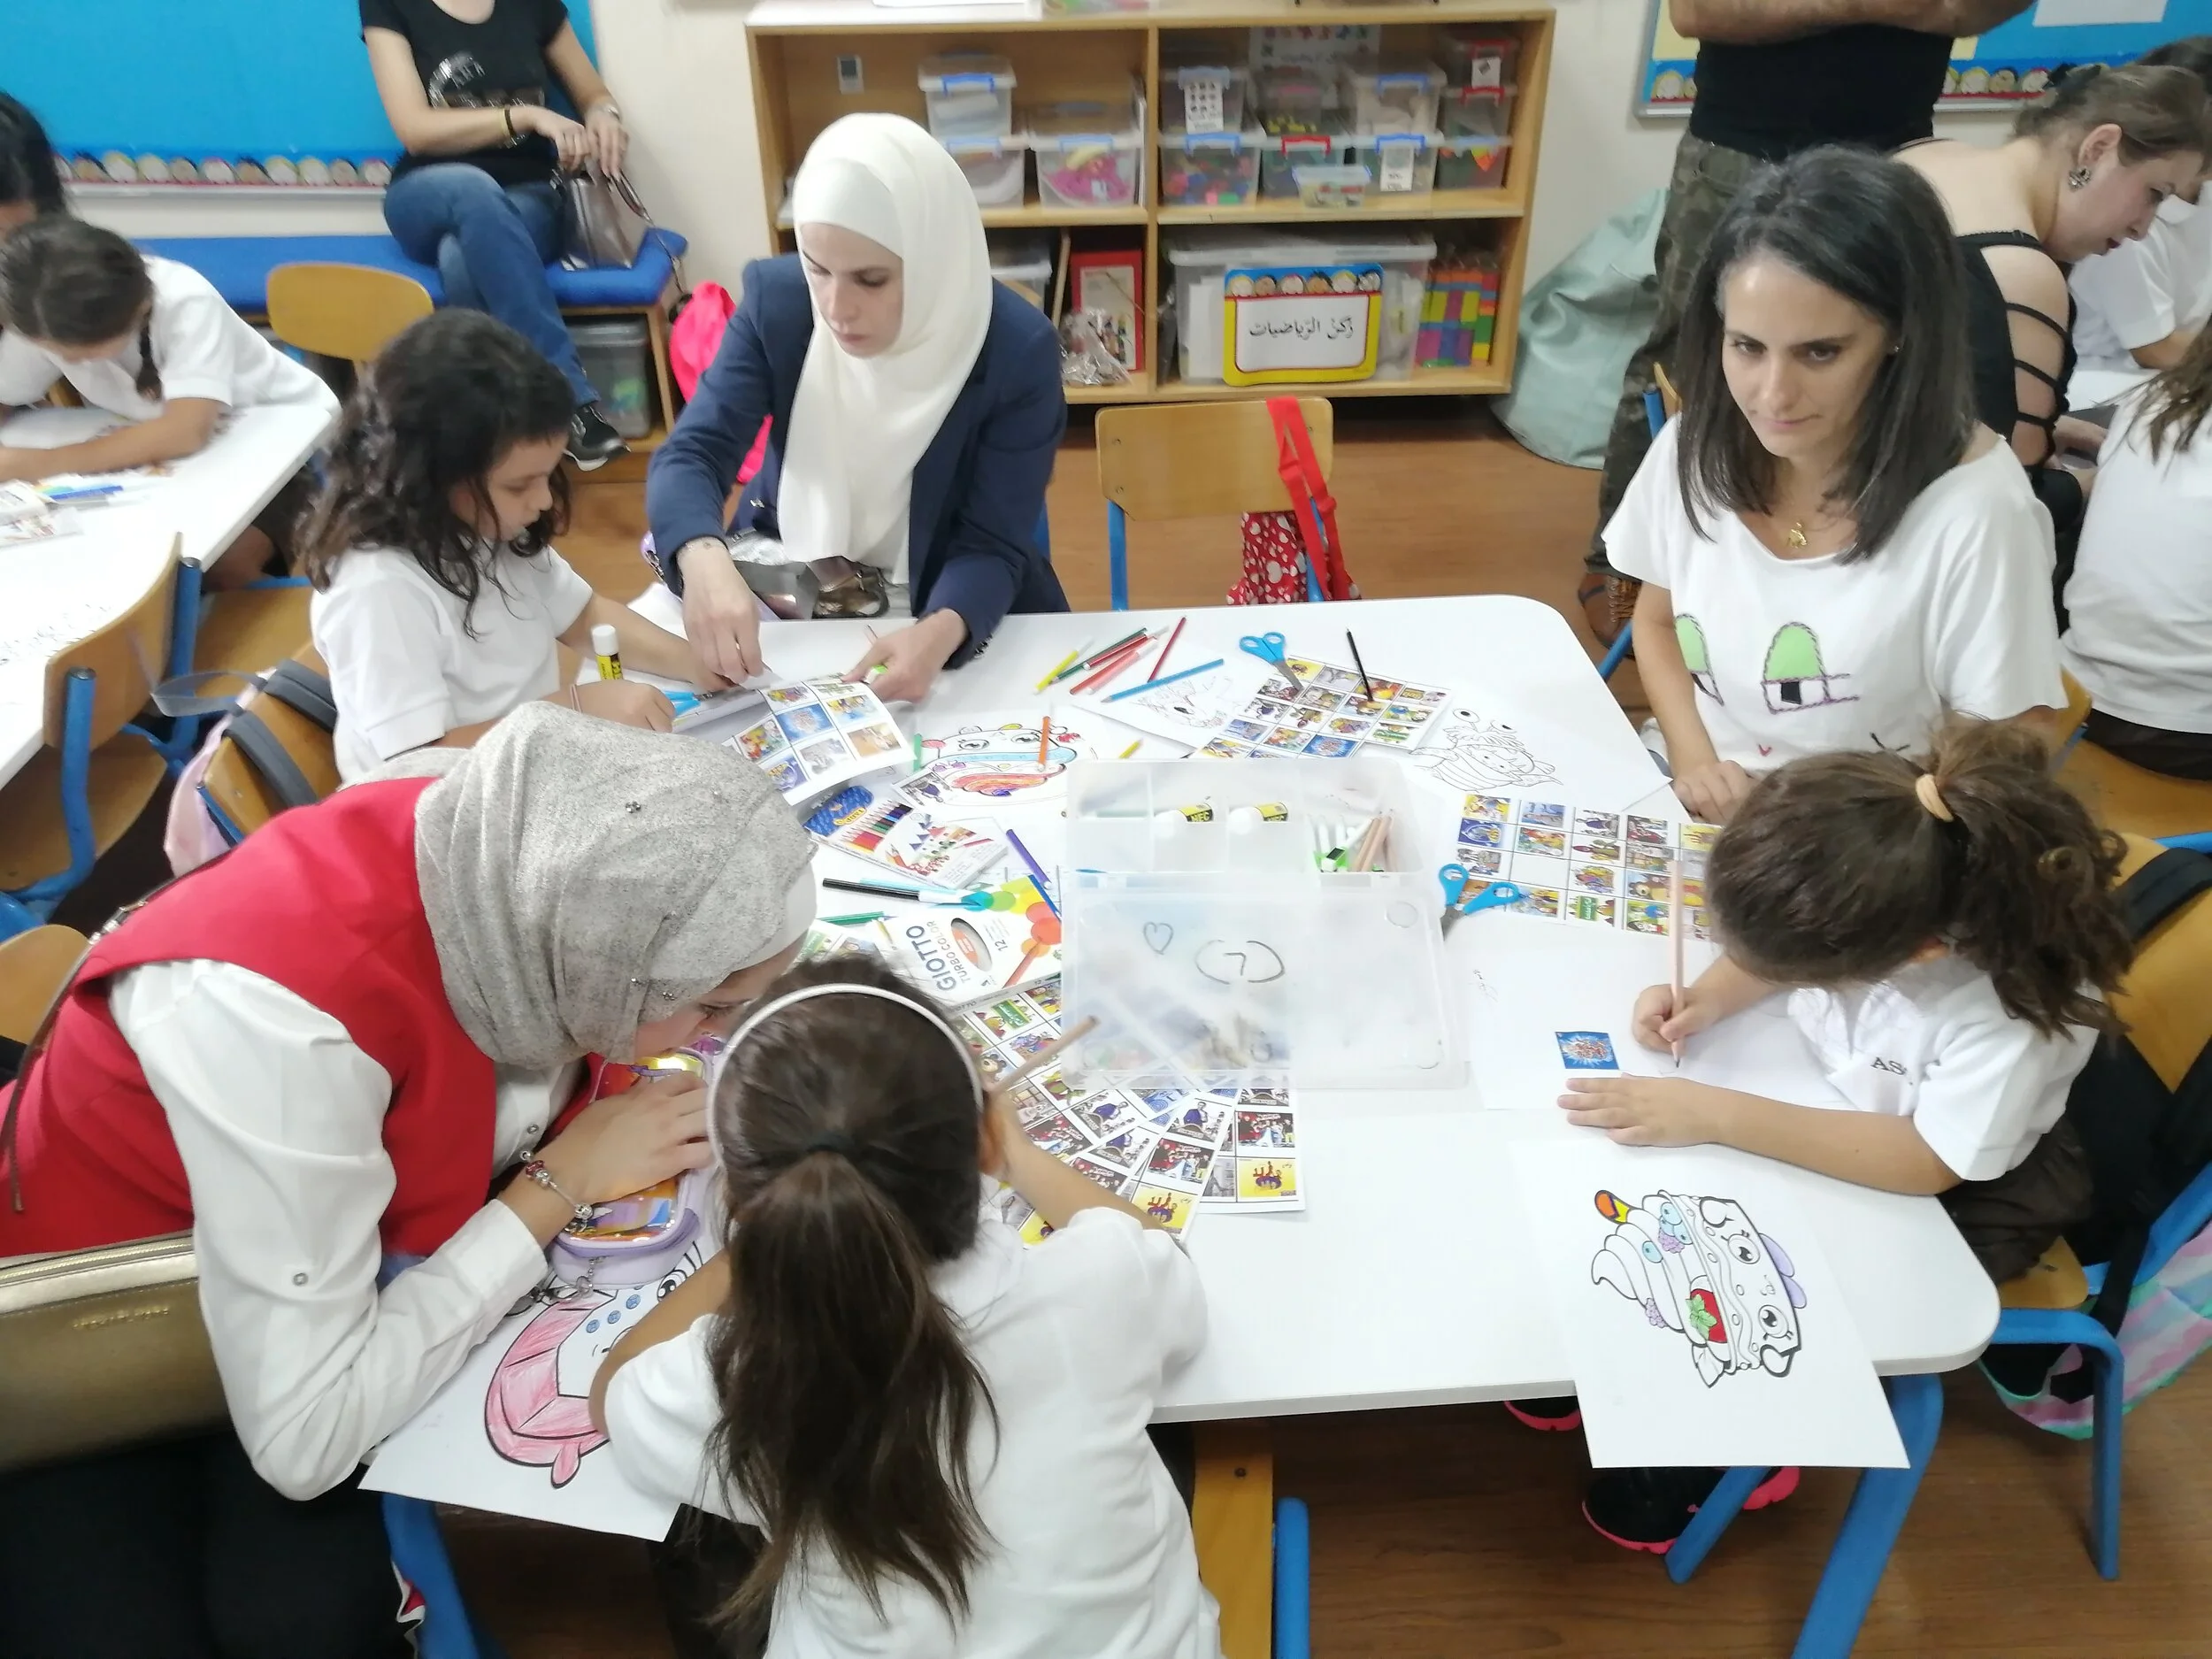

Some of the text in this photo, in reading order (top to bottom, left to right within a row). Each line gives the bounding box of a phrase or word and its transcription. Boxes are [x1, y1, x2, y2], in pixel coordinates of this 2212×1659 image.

[926, 920, 951, 951] COLOR
[994, 939, 1010, 952] 12
[905, 925, 957, 992] GIOTTO
[946, 951, 972, 984] TURBO
